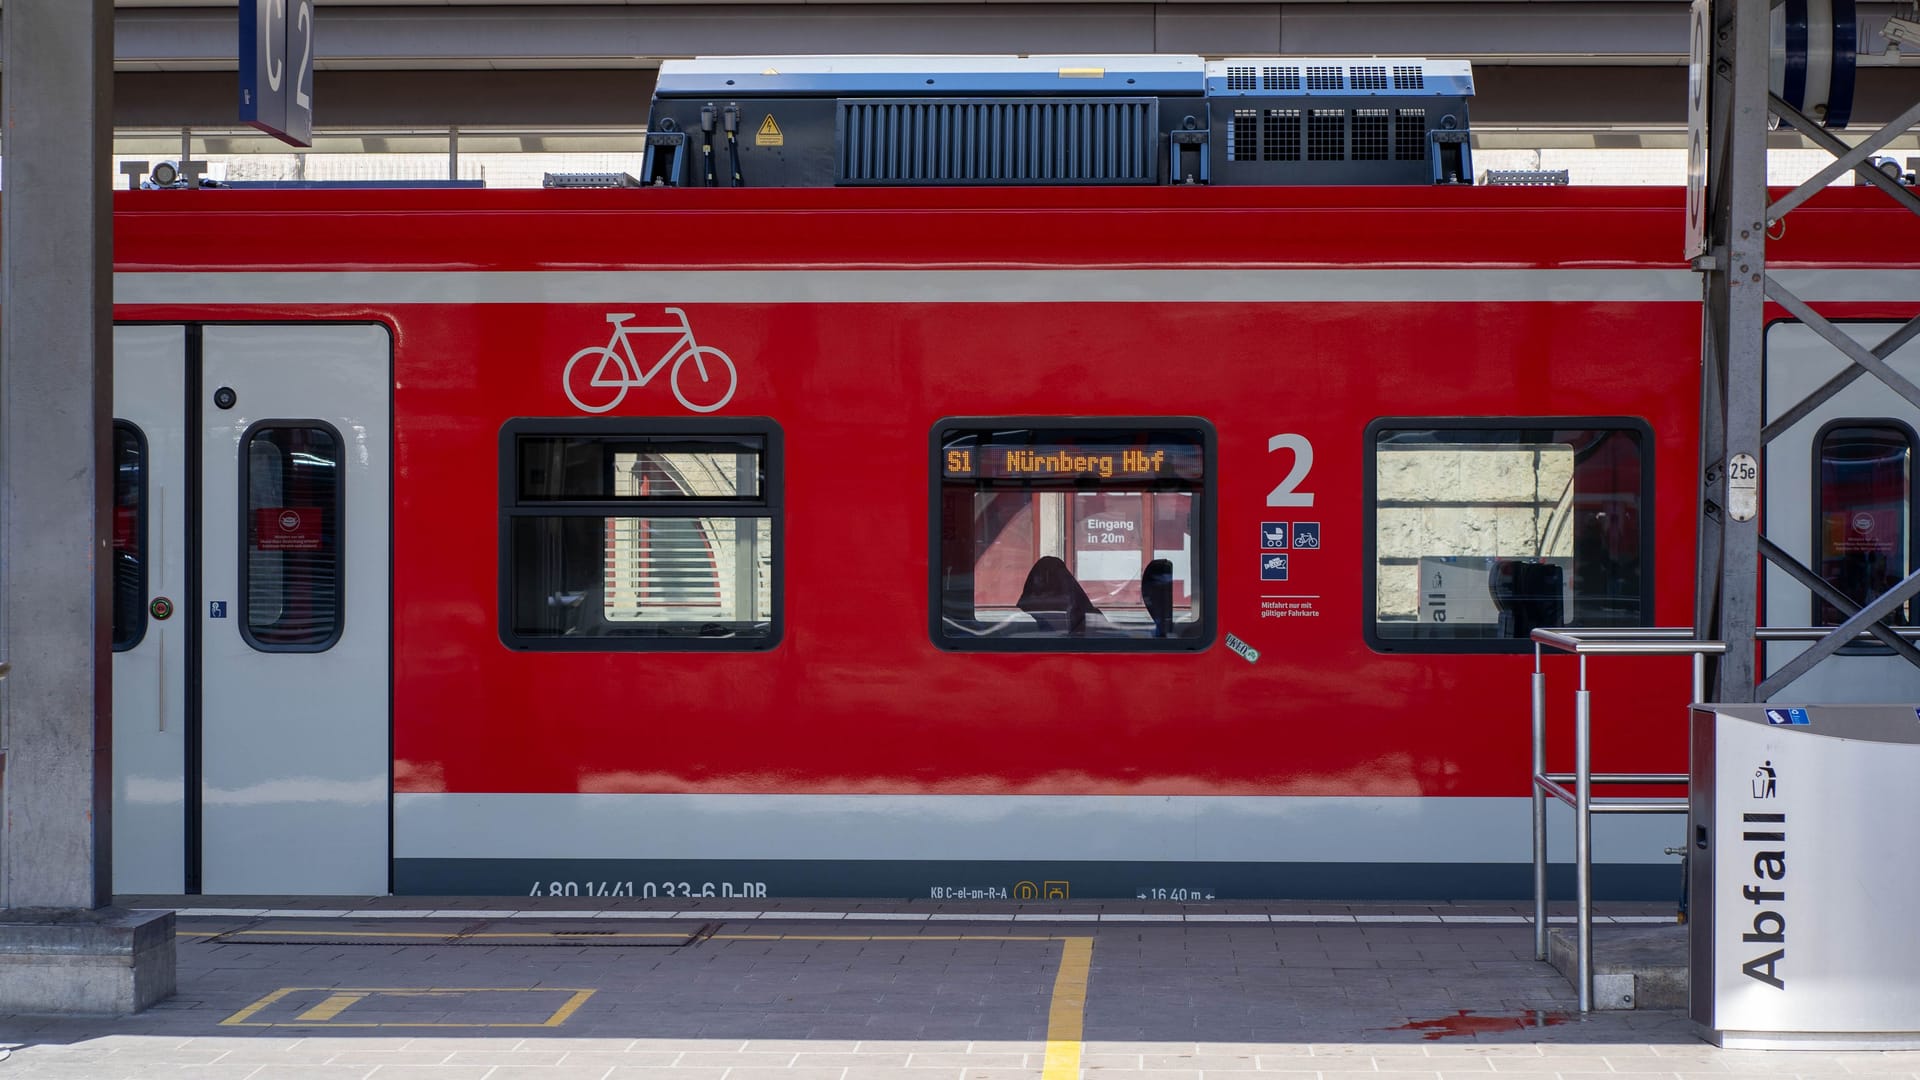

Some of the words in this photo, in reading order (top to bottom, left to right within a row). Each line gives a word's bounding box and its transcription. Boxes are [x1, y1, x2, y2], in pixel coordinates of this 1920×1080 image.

[265, 0, 282, 92] C
[296, 1, 310, 110] 2
[947, 450, 972, 472] S1
[1007, 450, 1112, 478] Nürnberg
[1123, 450, 1164, 472] Hbf
[1266, 433, 1315, 508] 2
[1730, 462, 1756, 480] 25e
[1087, 518, 1134, 531] Eingang
[1087, 532, 1098, 544] in
[1100, 532, 1125, 544] 20m
[1261, 609, 1287, 618] gültiger
[1288, 609, 1320, 617] Fahrkarte
[1742, 813, 1786, 990] Abfall
